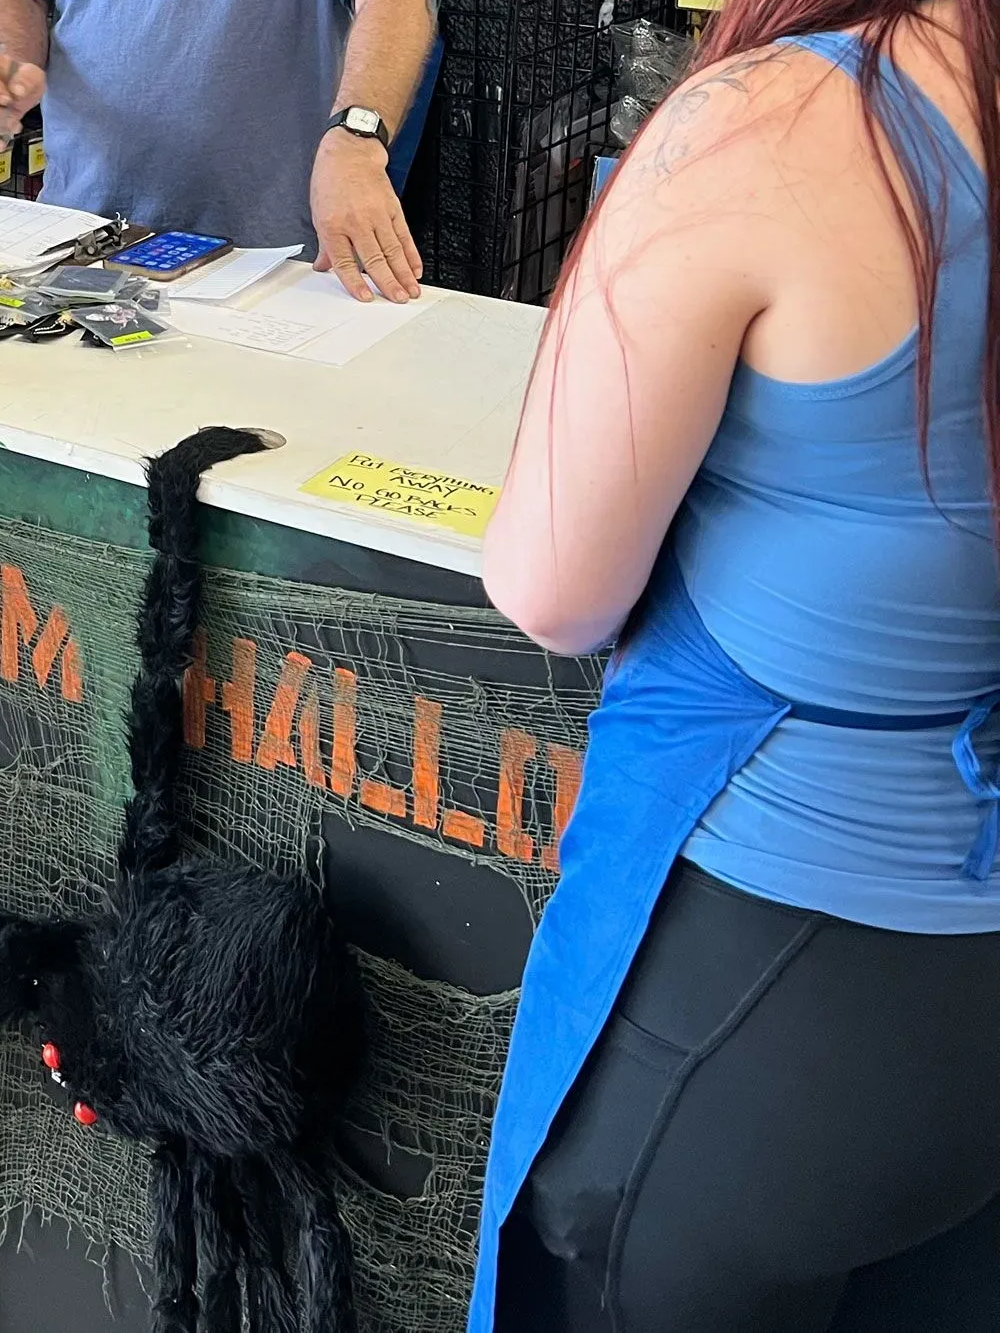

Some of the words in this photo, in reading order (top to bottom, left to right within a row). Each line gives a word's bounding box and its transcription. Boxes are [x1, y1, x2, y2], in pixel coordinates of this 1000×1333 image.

[329, 475, 365, 491] NO
[403, 491, 478, 517] BACKS
[390, 477, 459, 499] AWAY
[355, 493, 441, 519] PLEASE
